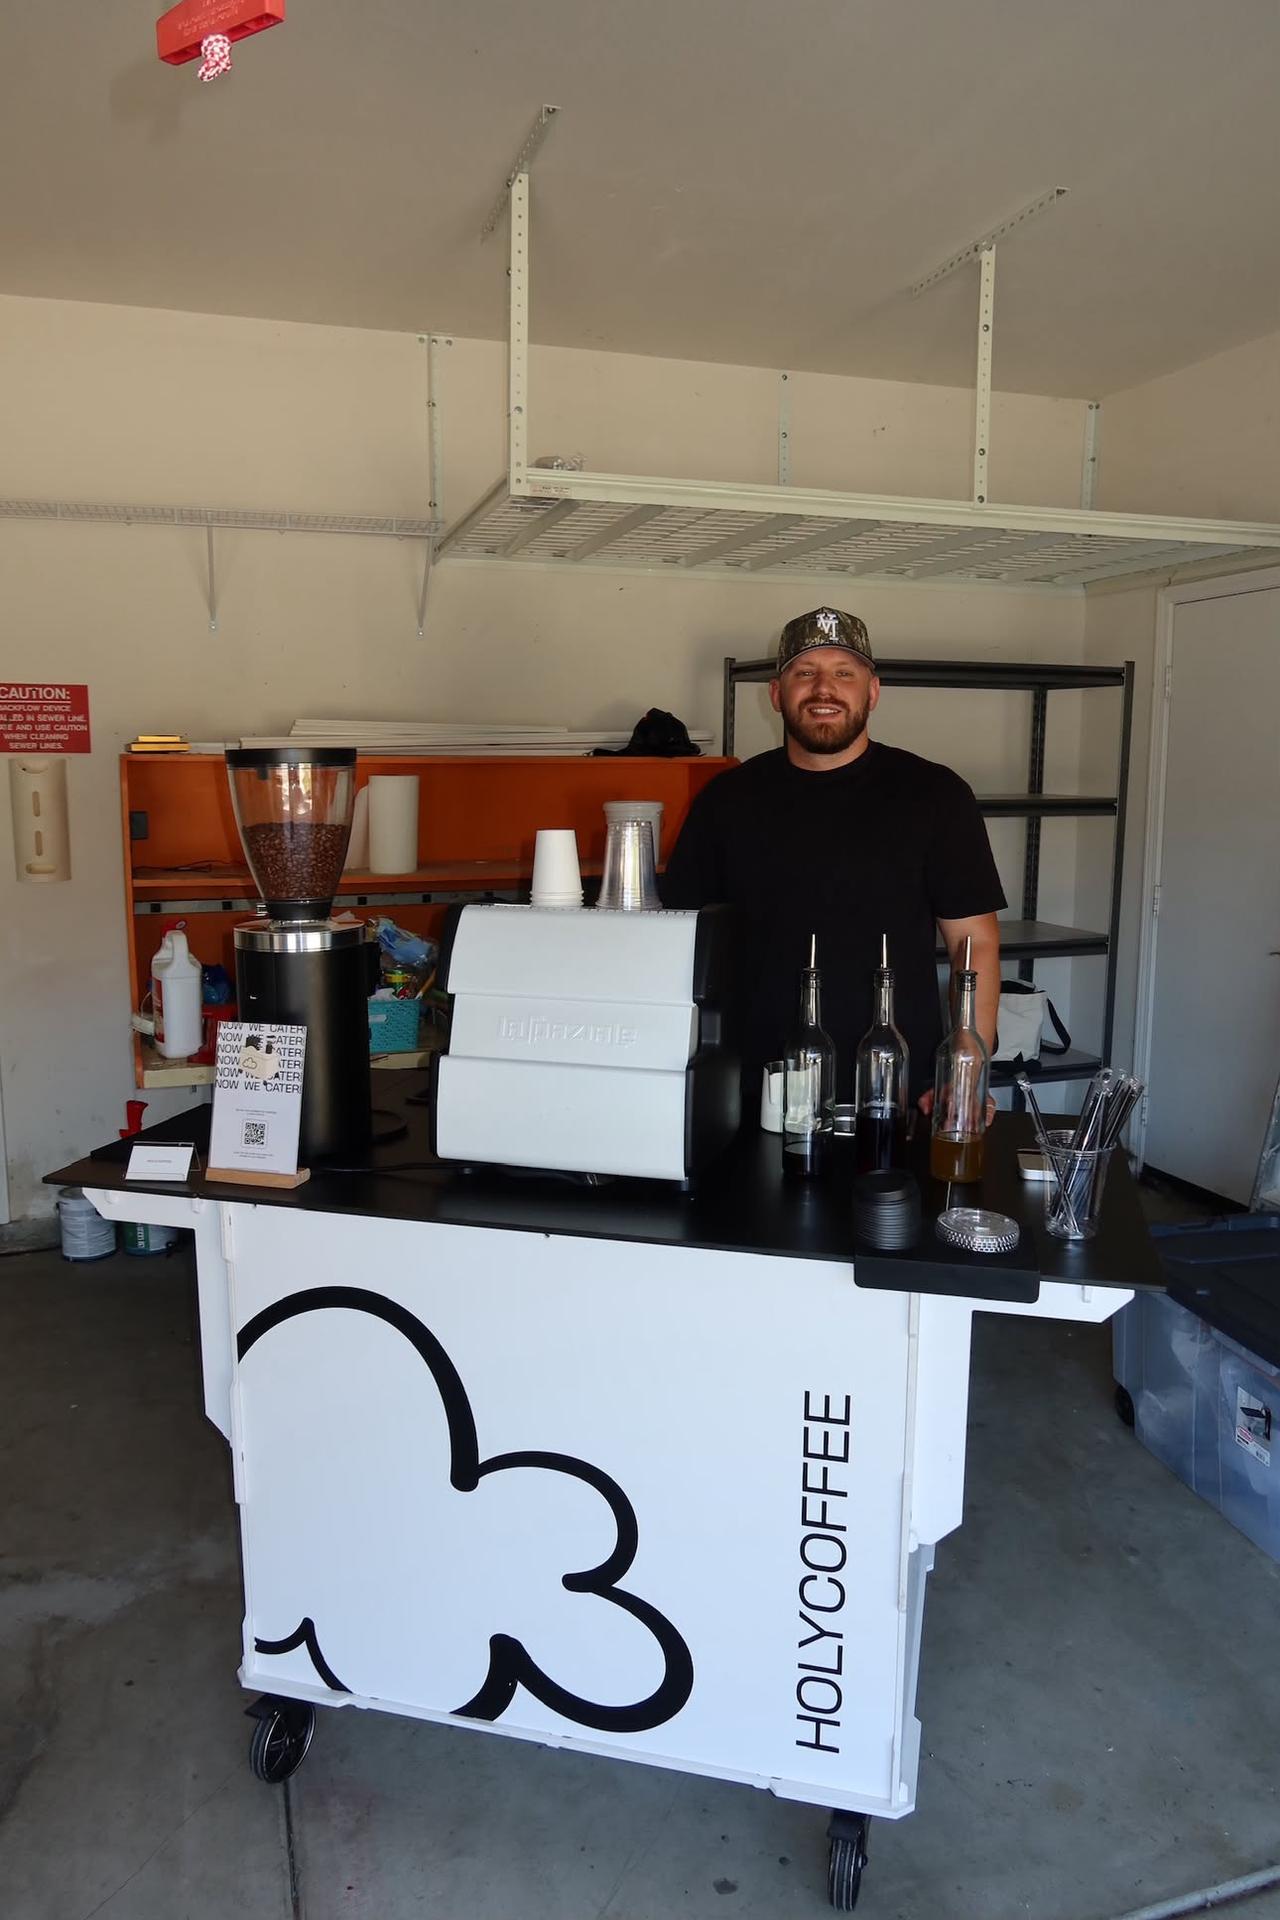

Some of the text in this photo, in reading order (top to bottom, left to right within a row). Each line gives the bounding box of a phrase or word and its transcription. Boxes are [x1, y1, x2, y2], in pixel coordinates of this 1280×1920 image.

[0, 687, 71, 700] CAUTION:
[37, 714, 66, 722] SEWER
[53, 724, 88, 732] CAUTION
[9, 742, 38, 750] SEWER
[218, 1032, 243, 1042] NOW
[217, 1044, 241, 1054] NOW
[216, 1056, 240, 1066] NOW
[215, 1067, 240, 1078] NOW
[214, 1079, 239, 1090] NOW
[244, 1081, 260, 1092] WE
[795, 1390, 851, 1754] HOLYCOFFEE
